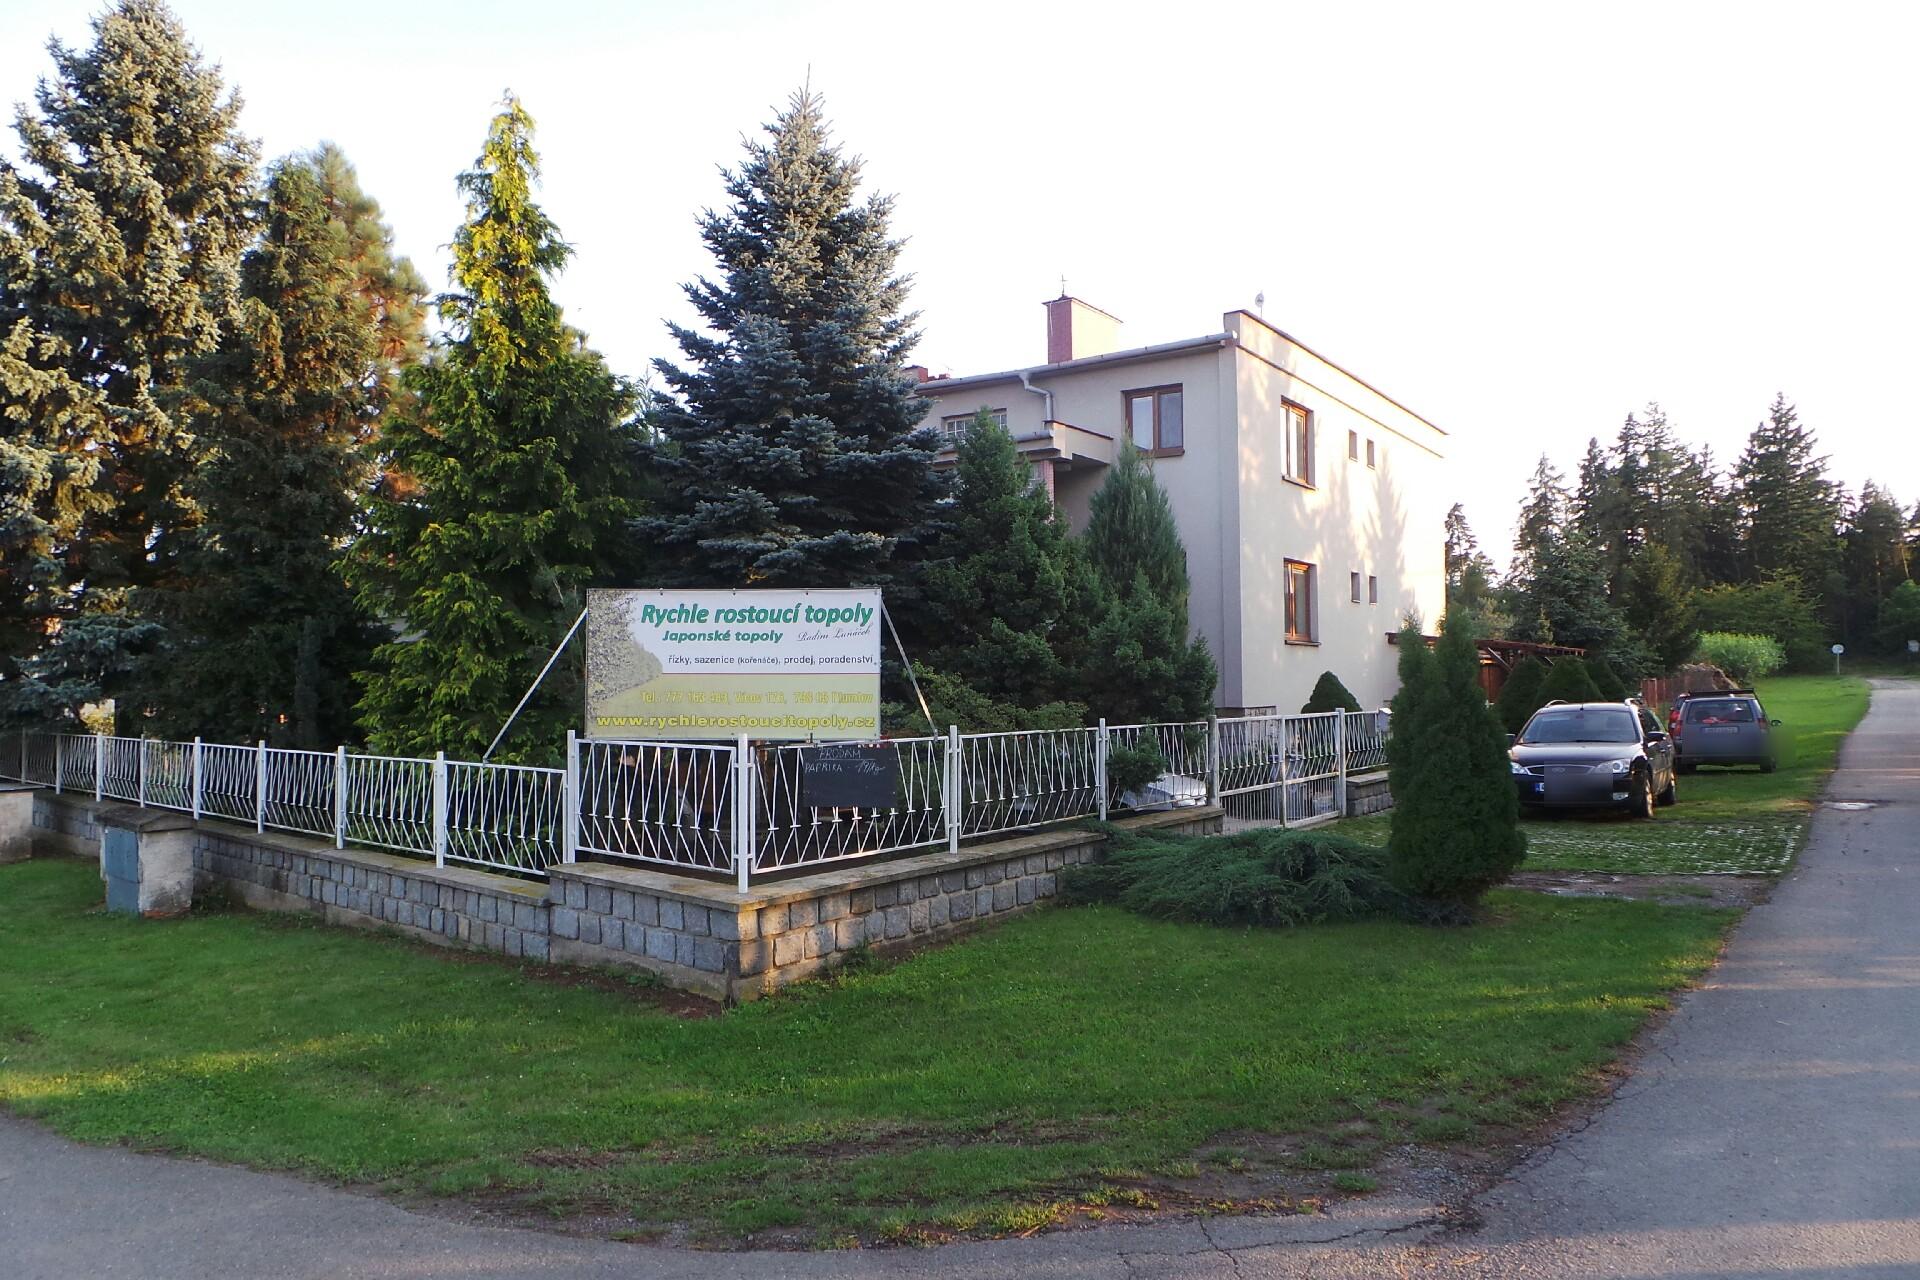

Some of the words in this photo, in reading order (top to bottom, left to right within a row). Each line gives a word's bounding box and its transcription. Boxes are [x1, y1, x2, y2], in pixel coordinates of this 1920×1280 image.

[641, 603, 708, 627] Rychle
[714, 603, 802, 624] rostoucí
[805, 602, 874, 627] topoly
[662, 629, 731, 643] Japonské
[735, 630, 783, 643] topoly
[668, 655, 692, 666] řízky,
[694, 655, 735, 664] sazenice
[784, 655, 816, 666] prodej,
[818, 655, 874, 666] poradenství
[597, 714, 875, 731] www.rychlerostoucitopoly.cz
[805, 762, 842, 774] PAPRIKA
